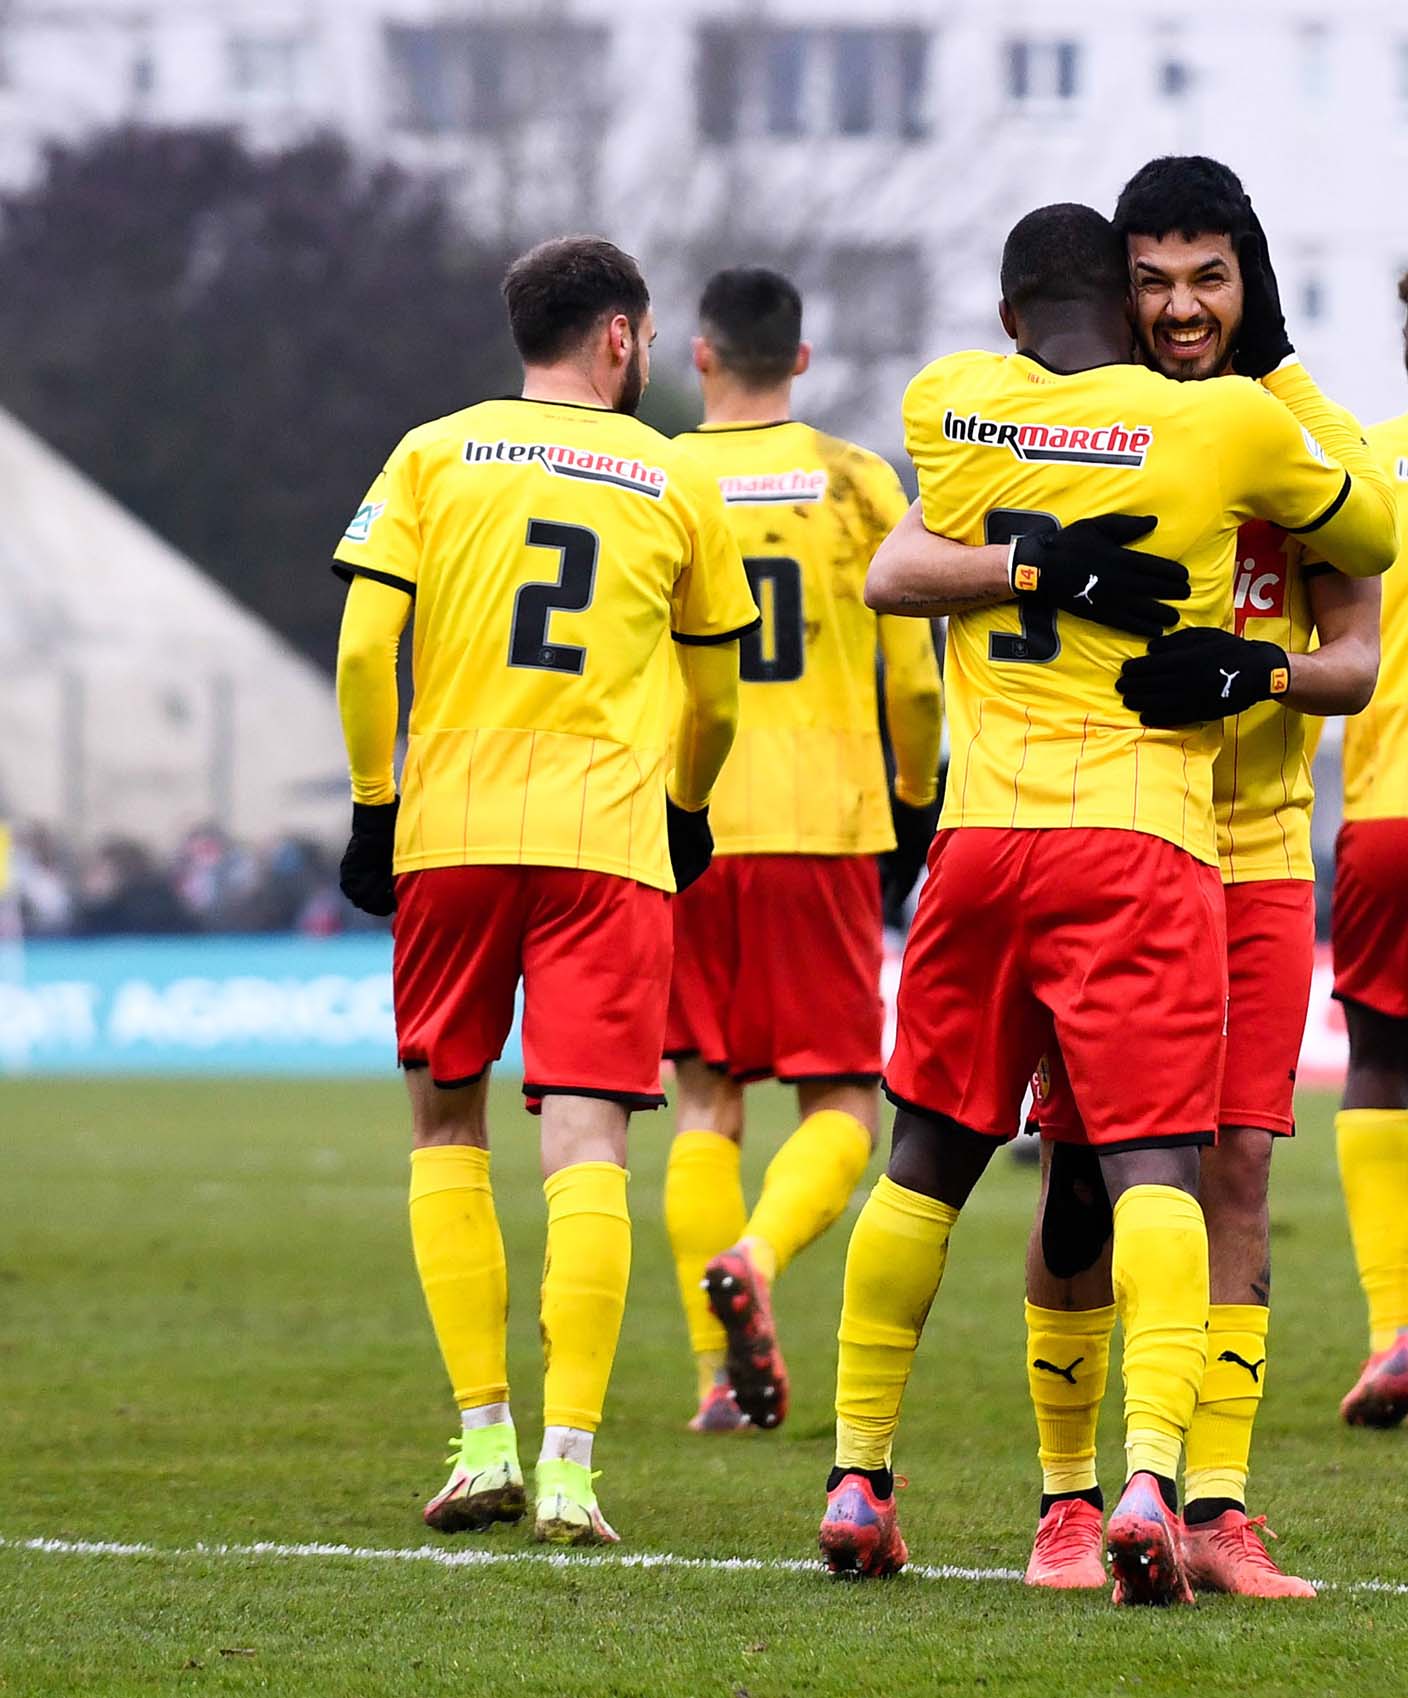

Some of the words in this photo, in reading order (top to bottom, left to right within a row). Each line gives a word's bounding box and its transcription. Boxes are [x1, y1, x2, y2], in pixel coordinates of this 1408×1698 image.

[944, 411, 1152, 456] Intermarché
[465, 441, 666, 487] Intermarché
[507, 518, 600, 675] 2
[1019, 568, 1035, 588] 14
[1274, 670, 1286, 691] 14
